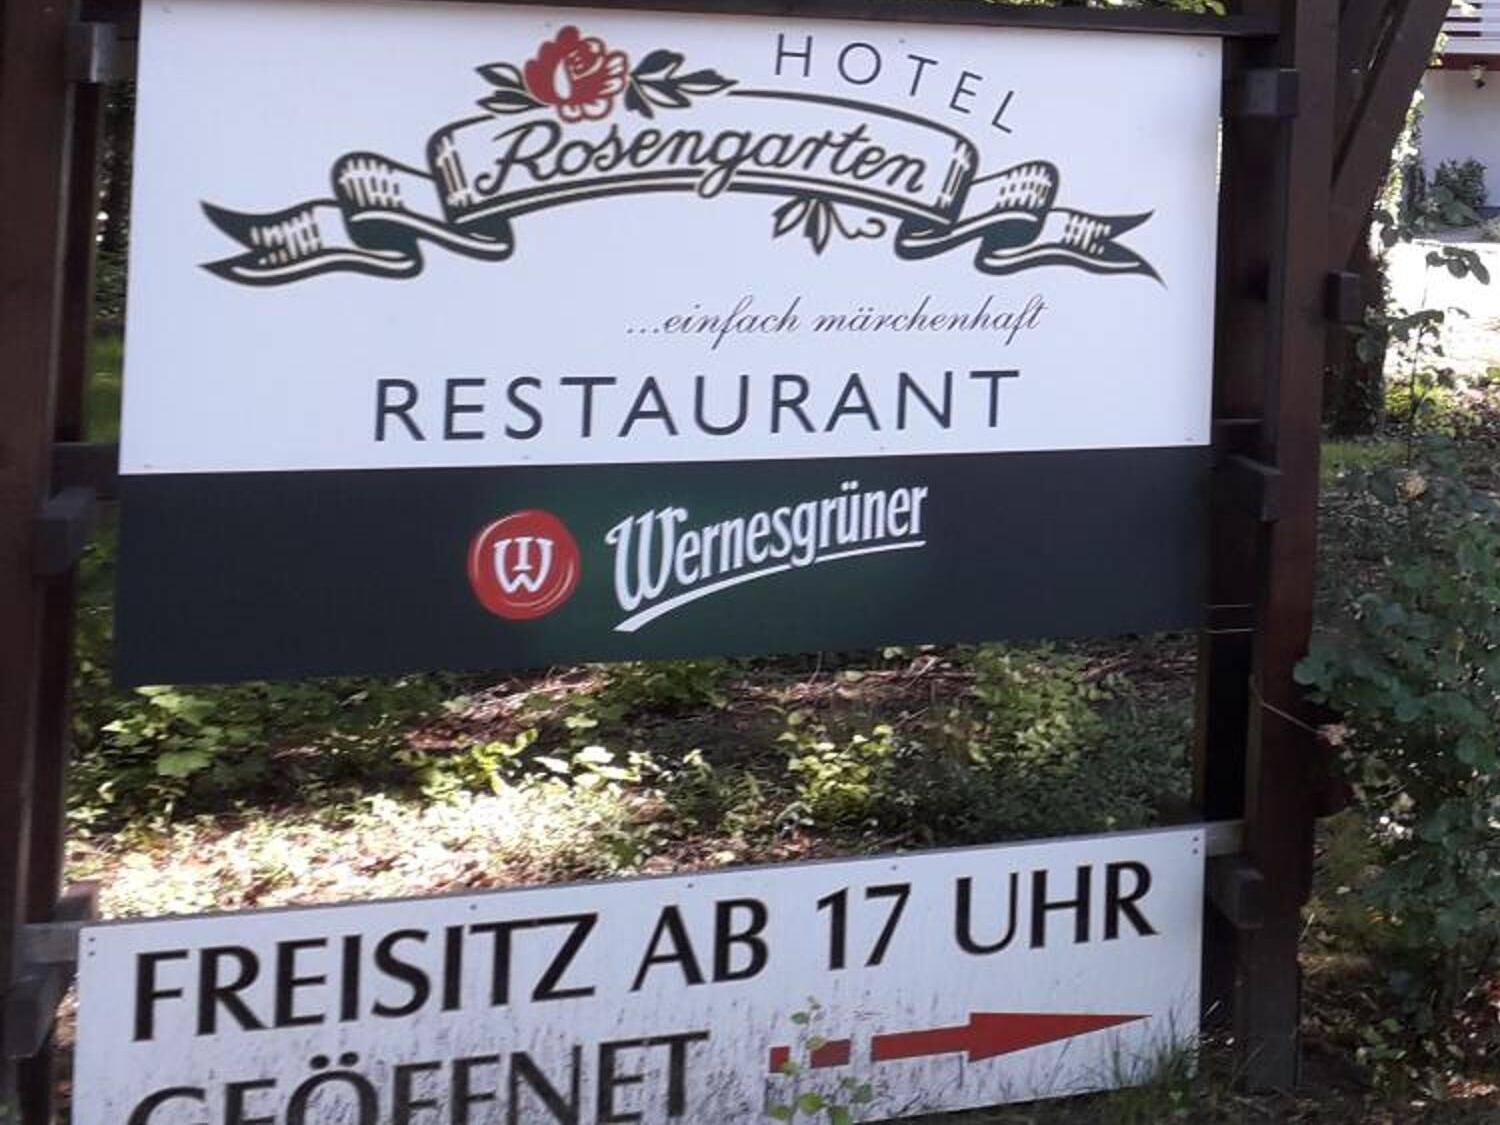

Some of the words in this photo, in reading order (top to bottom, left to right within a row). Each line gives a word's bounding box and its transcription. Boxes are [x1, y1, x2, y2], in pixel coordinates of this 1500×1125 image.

[774, 33, 1019, 134] HOTEL
[474, 120, 928, 199] Rosengarten
[627, 294, 802, 350] ...einfach
[813, 294, 1049, 346] märchenhaft
[373, 370, 1021, 442] RESTAURANT
[605, 481, 928, 612] Wernesgrüner
[133, 913, 597, 1041] FREISITZ
[631, 897, 769, 991] AB
[816, 882, 912, 970] 17
[955, 861, 1160, 955] UHR
